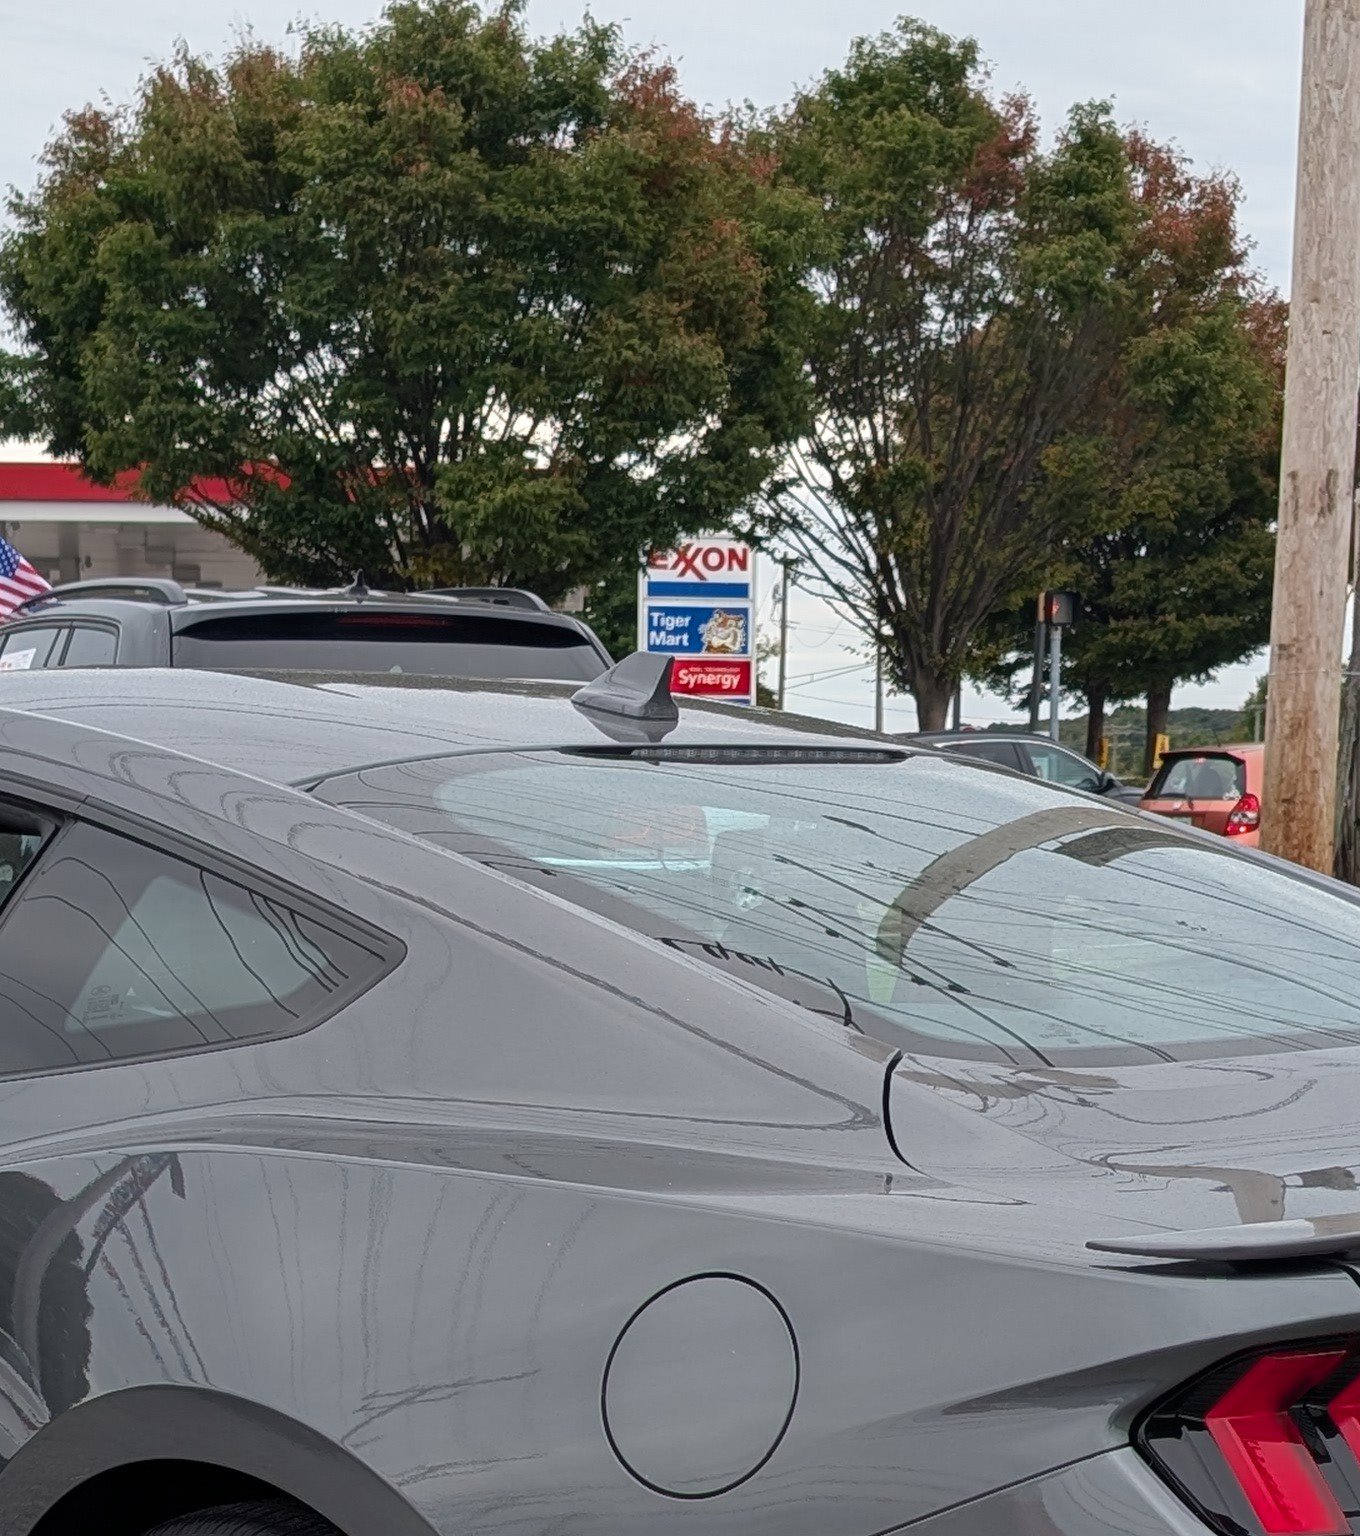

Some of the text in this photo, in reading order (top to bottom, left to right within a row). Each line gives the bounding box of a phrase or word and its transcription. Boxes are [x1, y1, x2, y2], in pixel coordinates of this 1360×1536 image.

[648, 543, 748, 581] EXXON
[650, 612, 691, 631] Tiger
[649, 631, 690, 647] Mart
[678, 669, 741, 690] Synergy
